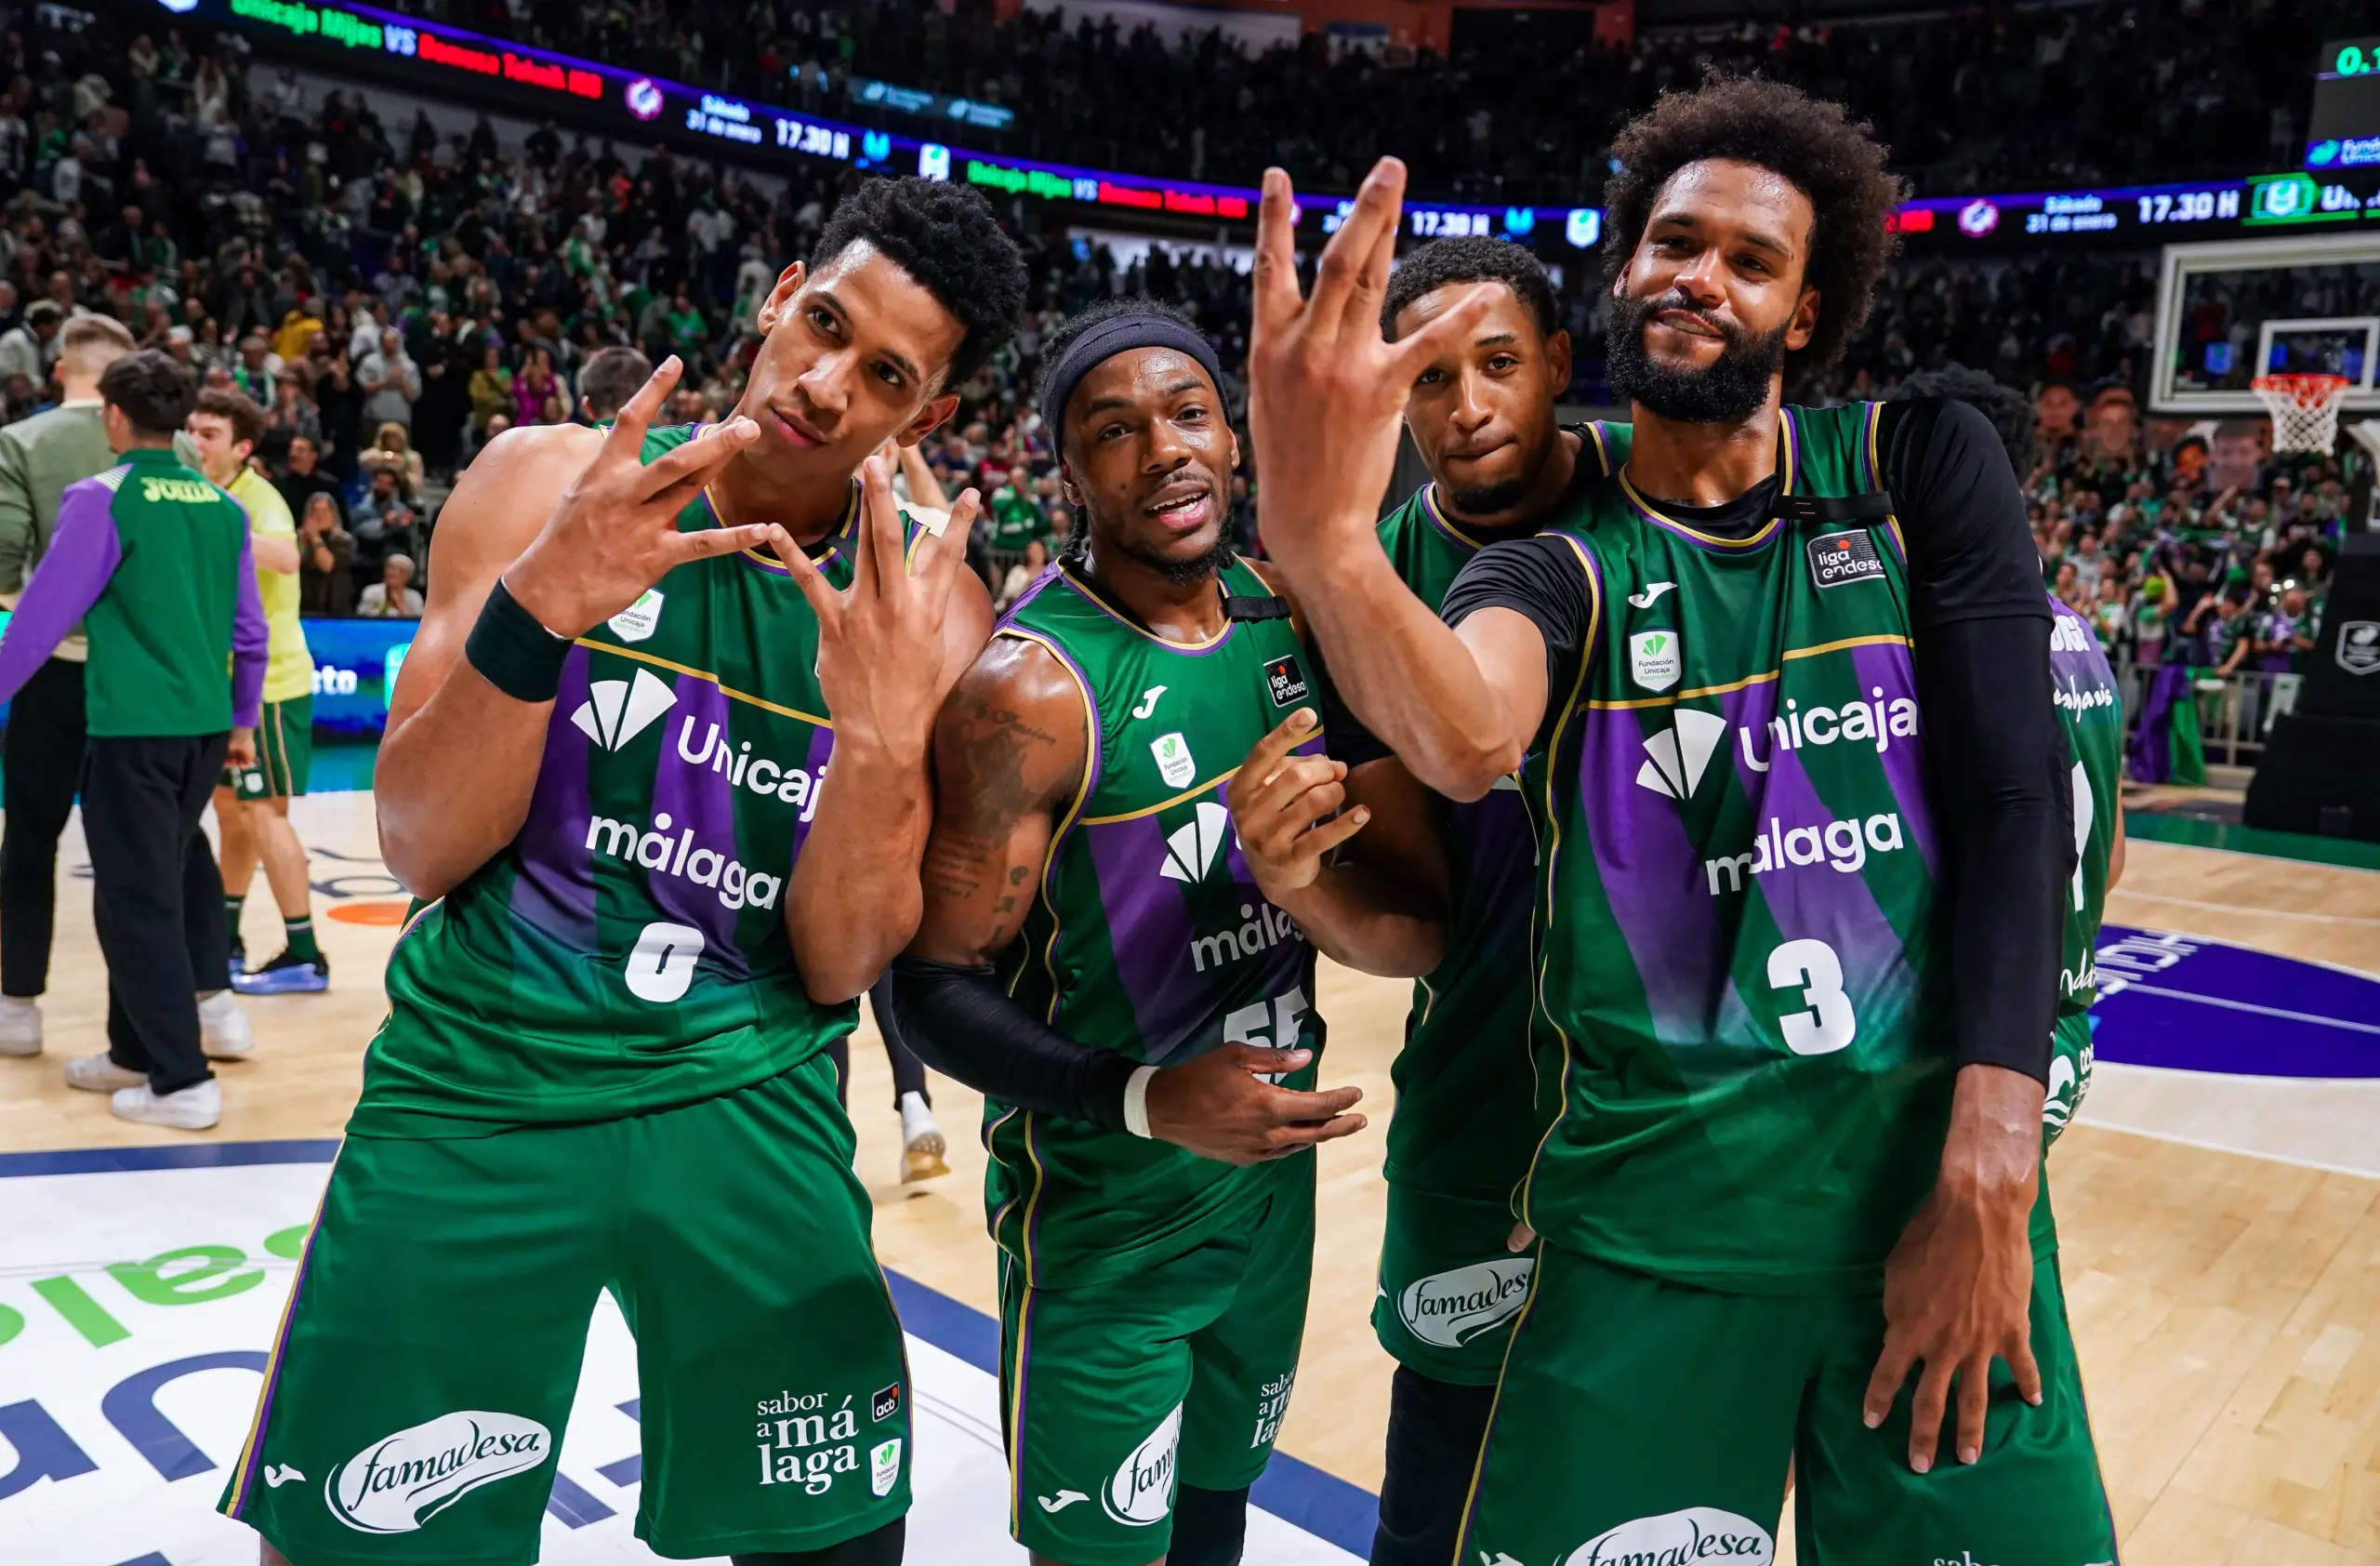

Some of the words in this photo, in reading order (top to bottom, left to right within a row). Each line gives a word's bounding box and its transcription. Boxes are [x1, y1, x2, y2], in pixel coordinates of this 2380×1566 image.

[384, 23, 416, 56] VS
[775, 118, 832, 156] 17.30
[2138, 193, 2215, 223] 17.30
[1818, 550, 1850, 566] liga
[1638, 658, 1674, 668] Fundación
[1271, 675, 1289, 689] liga
[1276, 682, 1306, 699] endesa
[678, 715, 827, 822] Unicaj
[625, 922, 706, 1003] 0
[1767, 938, 1857, 1055] 3
[1409, 1268, 1527, 1324] famades
[757, 1390, 828, 1416] sabor
[876, 1400, 895, 1417] acb
[756, 1422, 772, 1438] a
[774, 1395, 859, 1449] má
[347, 1419, 539, 1511] famadesa
[757, 1443, 860, 1495] laga
